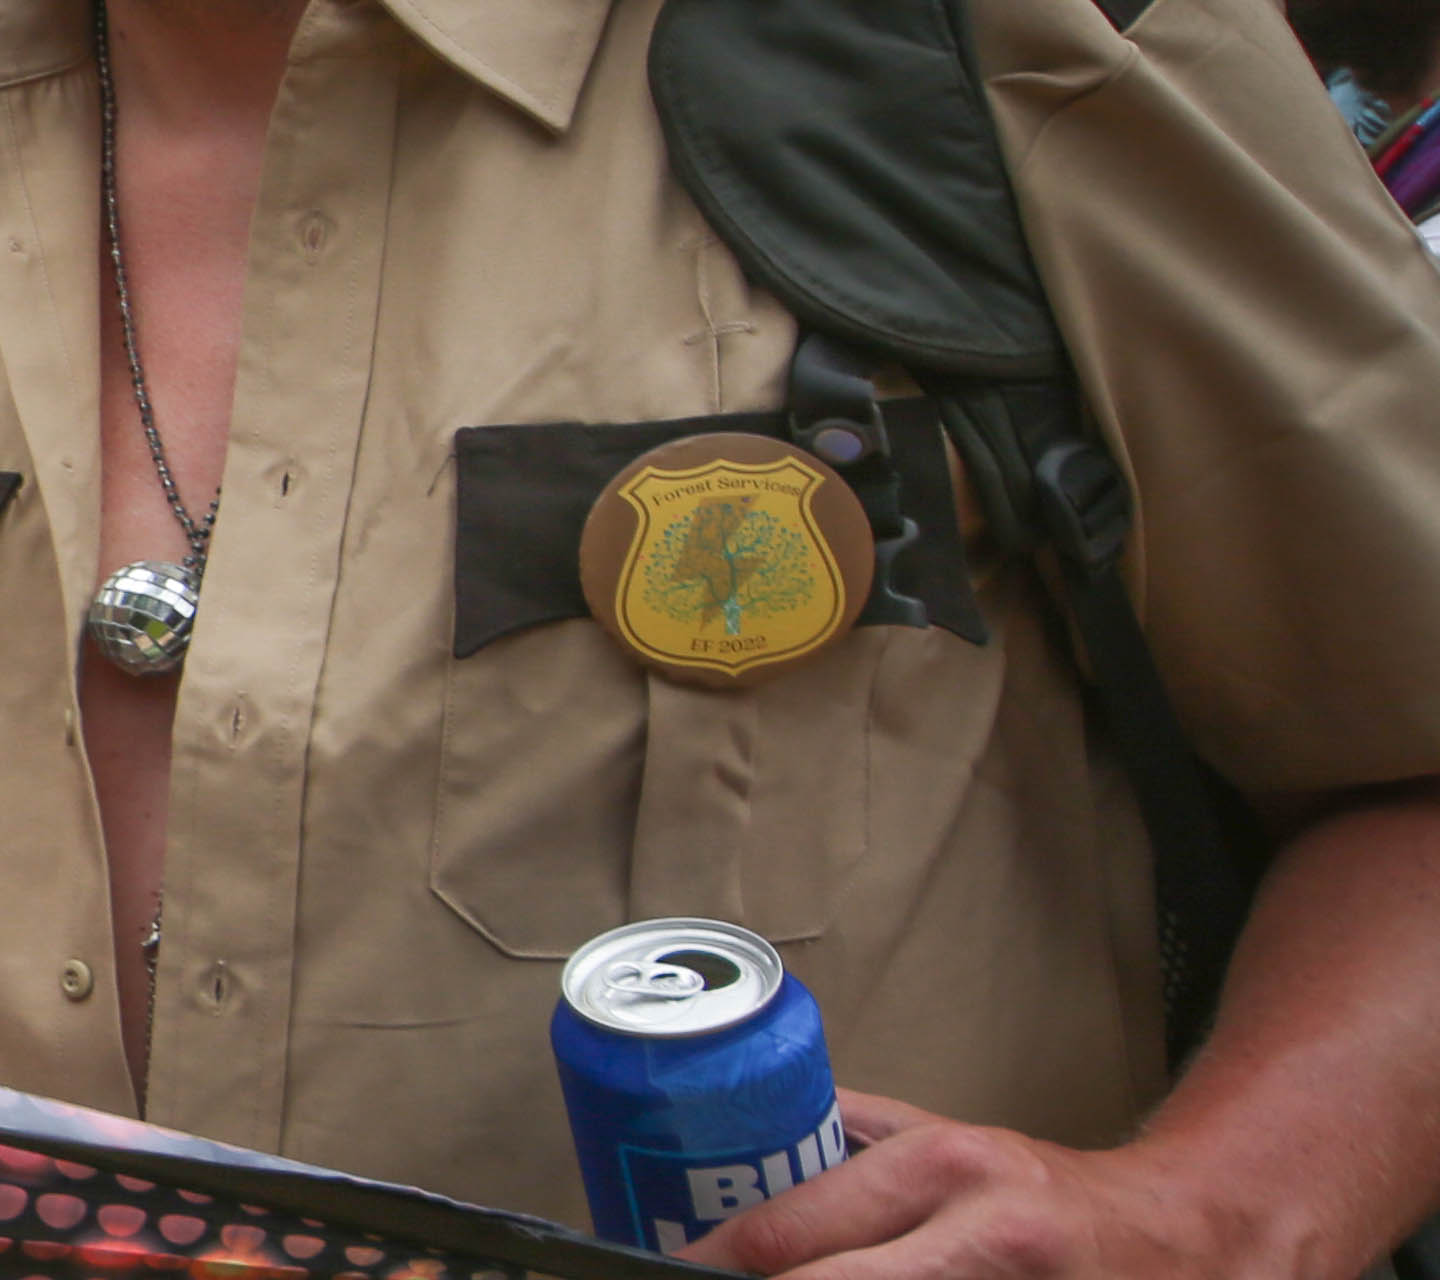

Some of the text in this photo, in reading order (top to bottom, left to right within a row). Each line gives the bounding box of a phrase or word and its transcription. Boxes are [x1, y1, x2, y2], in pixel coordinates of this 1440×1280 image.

[651, 477, 801, 506] Forest Services
[719, 635, 769, 654] 2022
